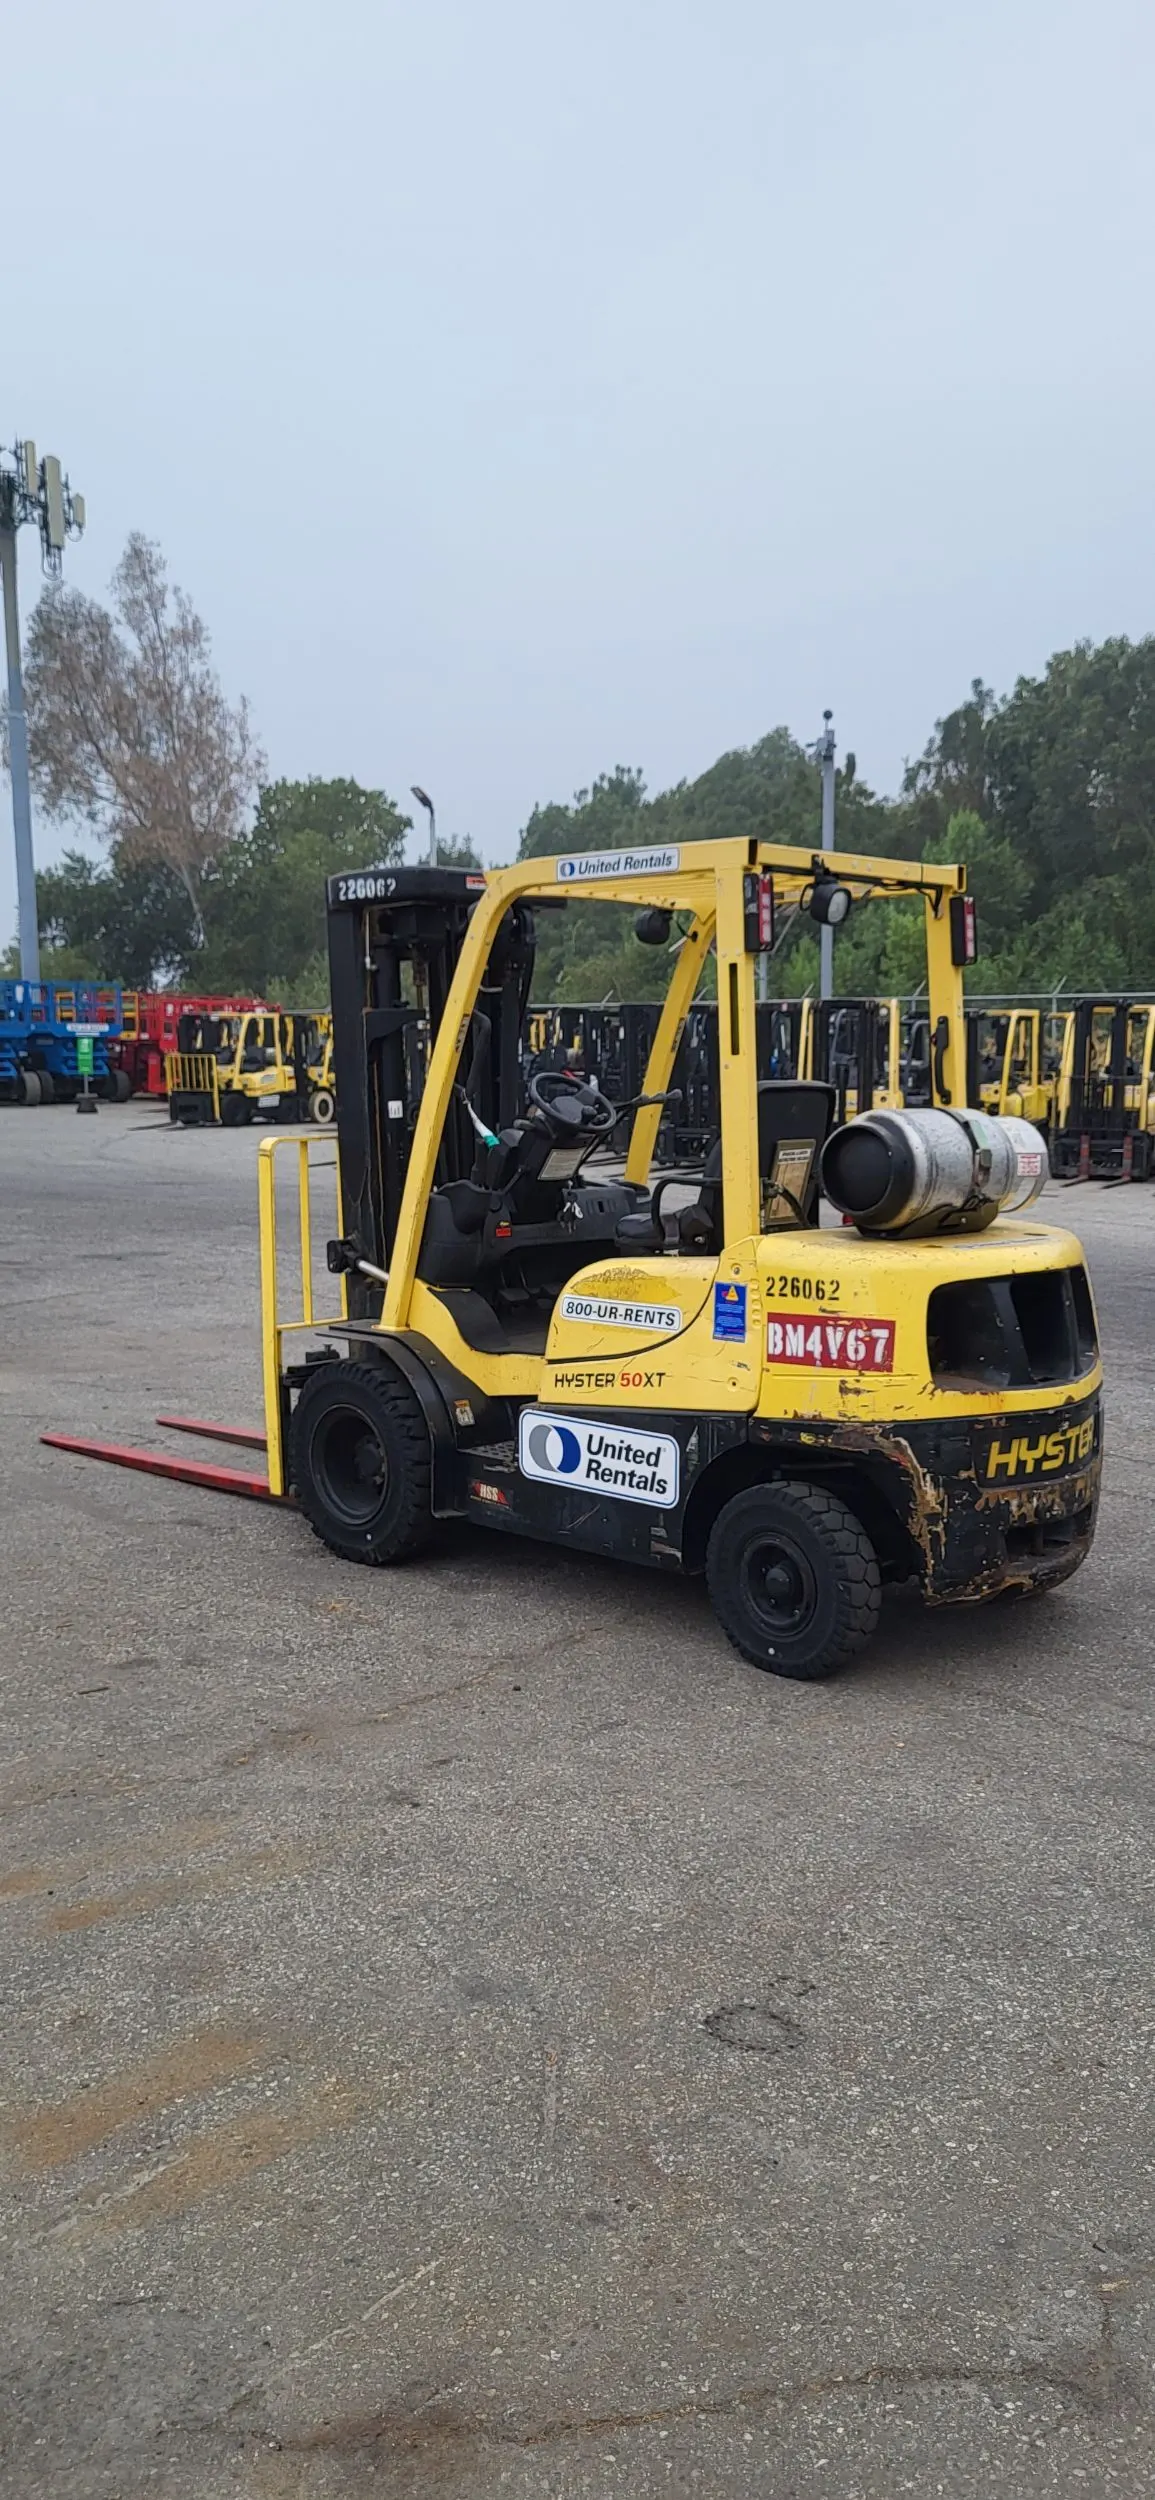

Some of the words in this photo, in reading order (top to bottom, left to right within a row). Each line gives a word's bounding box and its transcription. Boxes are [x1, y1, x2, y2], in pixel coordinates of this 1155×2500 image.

[579, 857, 620, 874] United
[624, 852, 672, 870] Rentals
[766, 1275, 840, 1300] 226062
[566, 1301, 676, 1326] 800-UR-RENTS
[767, 1322, 889, 1363] BM4V67
[554, 1373, 616, 1387] HYSTER
[620, 1372, 666, 1387] 50XT
[587, 1434, 661, 1467] United
[585, 1458, 668, 1494] Rentals
